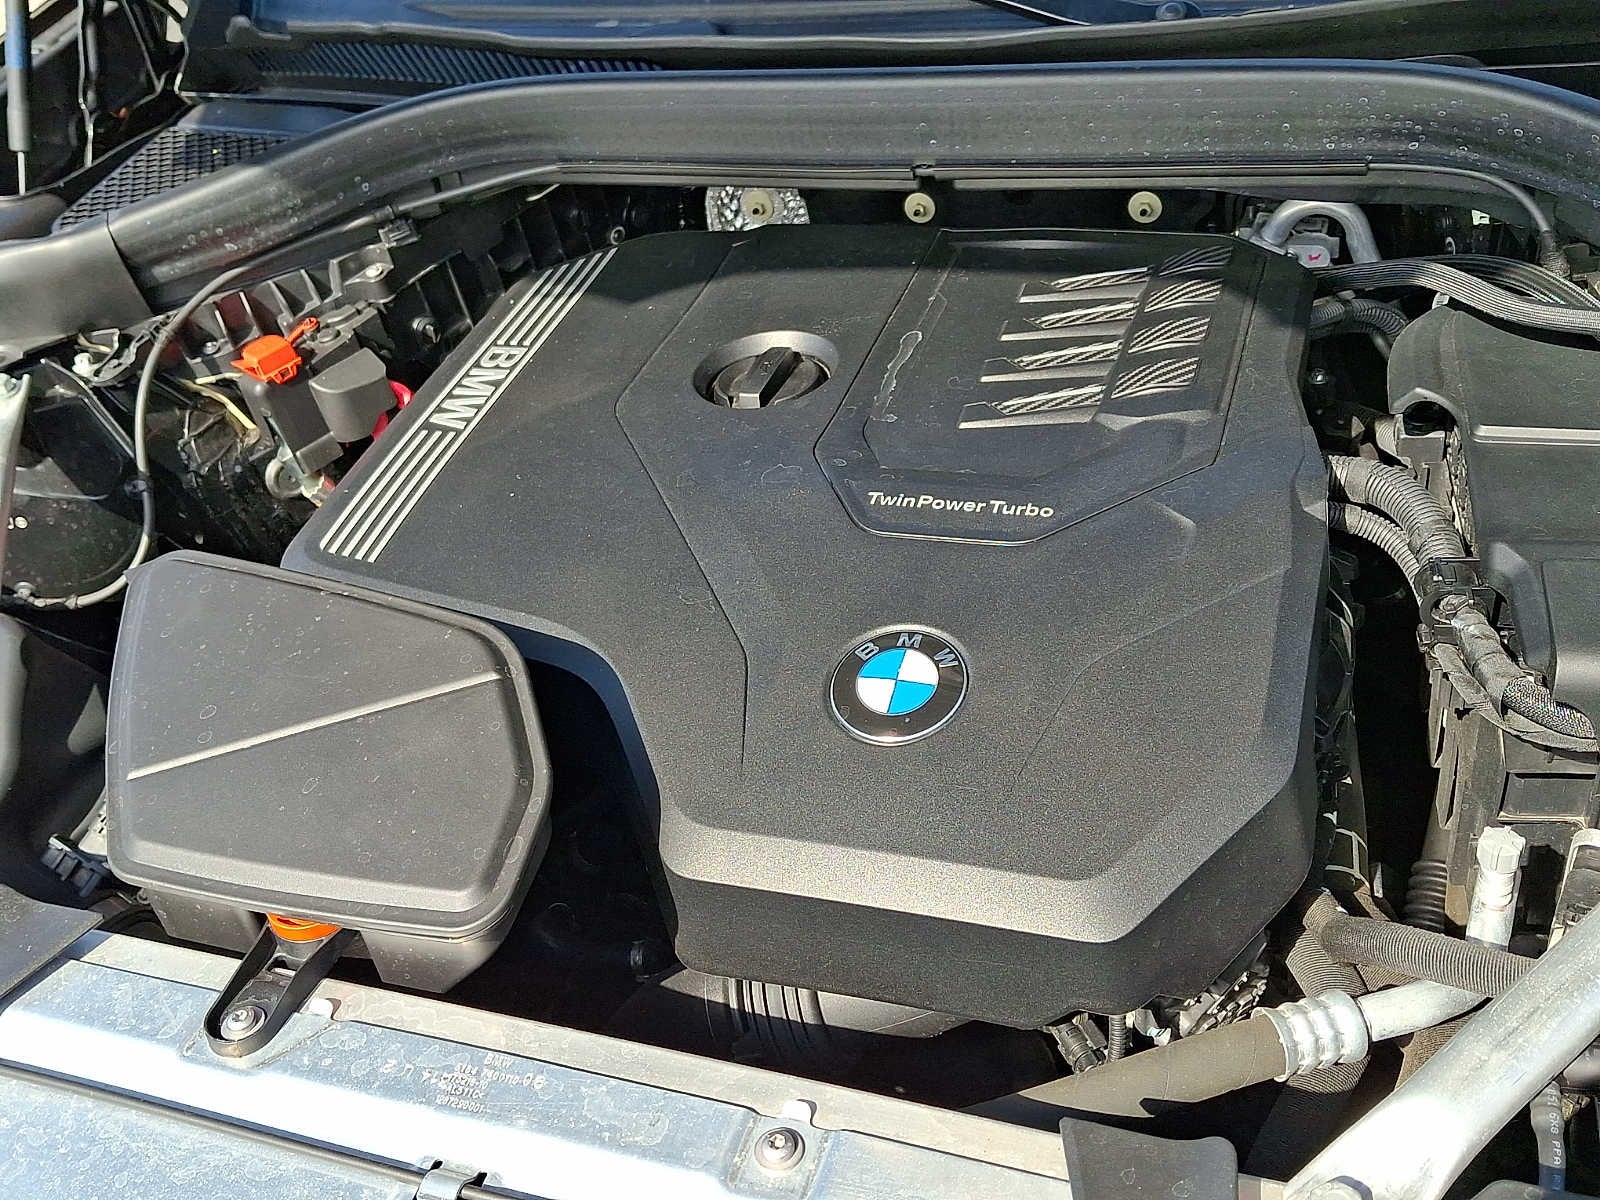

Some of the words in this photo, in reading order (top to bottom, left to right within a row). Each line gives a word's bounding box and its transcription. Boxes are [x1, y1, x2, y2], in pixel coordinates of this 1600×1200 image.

[428, 346, 529, 430] BMW
[867, 491, 986, 513] TwinPower
[989, 500, 1055, 518] Turbo
[854, 632, 960, 668] BMW
[484, 1052, 513, 1069] BMW
[1551, 1139, 1562, 1166] PPA
